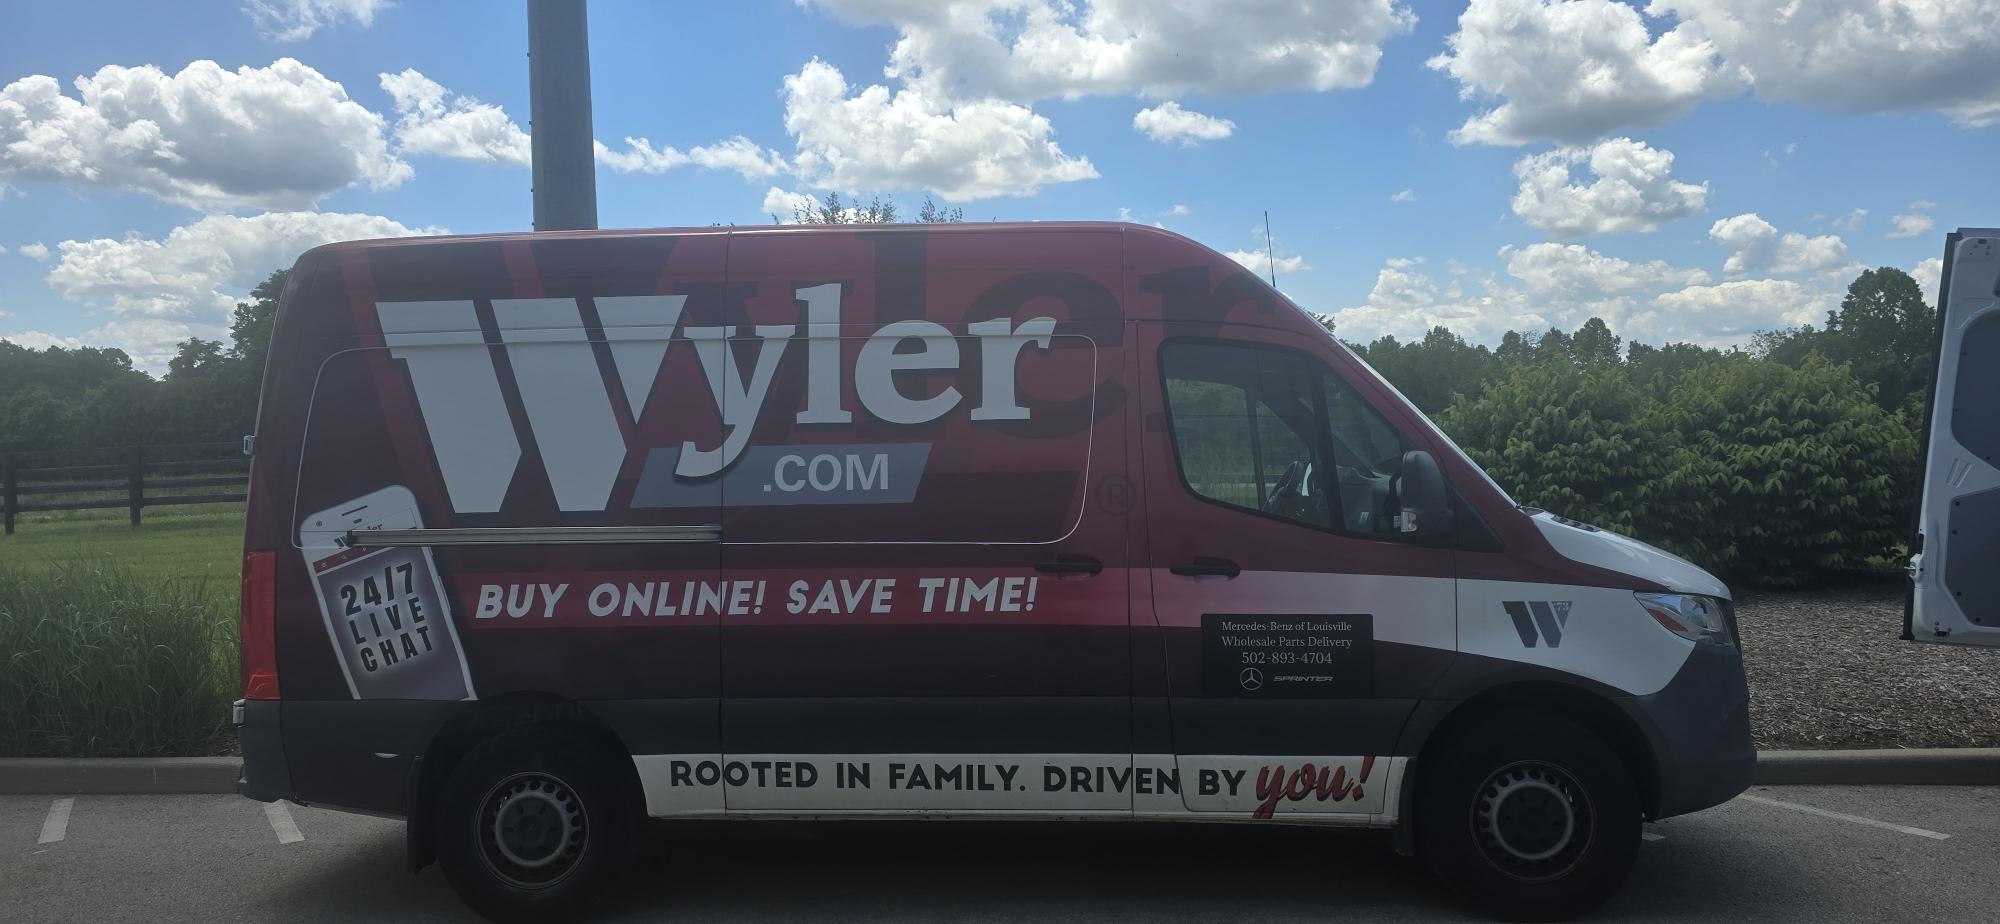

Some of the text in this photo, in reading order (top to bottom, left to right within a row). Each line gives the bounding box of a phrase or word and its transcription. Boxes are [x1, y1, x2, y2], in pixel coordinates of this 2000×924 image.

[374, 283, 1058, 514] Wyler
[763, 453, 890, 494] .COM
[340, 562, 413, 616] 24/7
[475, 576, 1039, 619] BUY ONLINE! SAVE TIME!
[348, 596, 425, 645] LIVE
[1222, 621, 1352, 631] Mercedes-Benz of Louisville
[1222, 636, 1352, 649] Wholesale Parts Delivery
[360, 626, 433, 672] CHAT
[1242, 651, 1333, 665] 502-893-4704
[670, 755, 1376, 819] ROOTED IN FAMILY. DRIVEN BY you!
